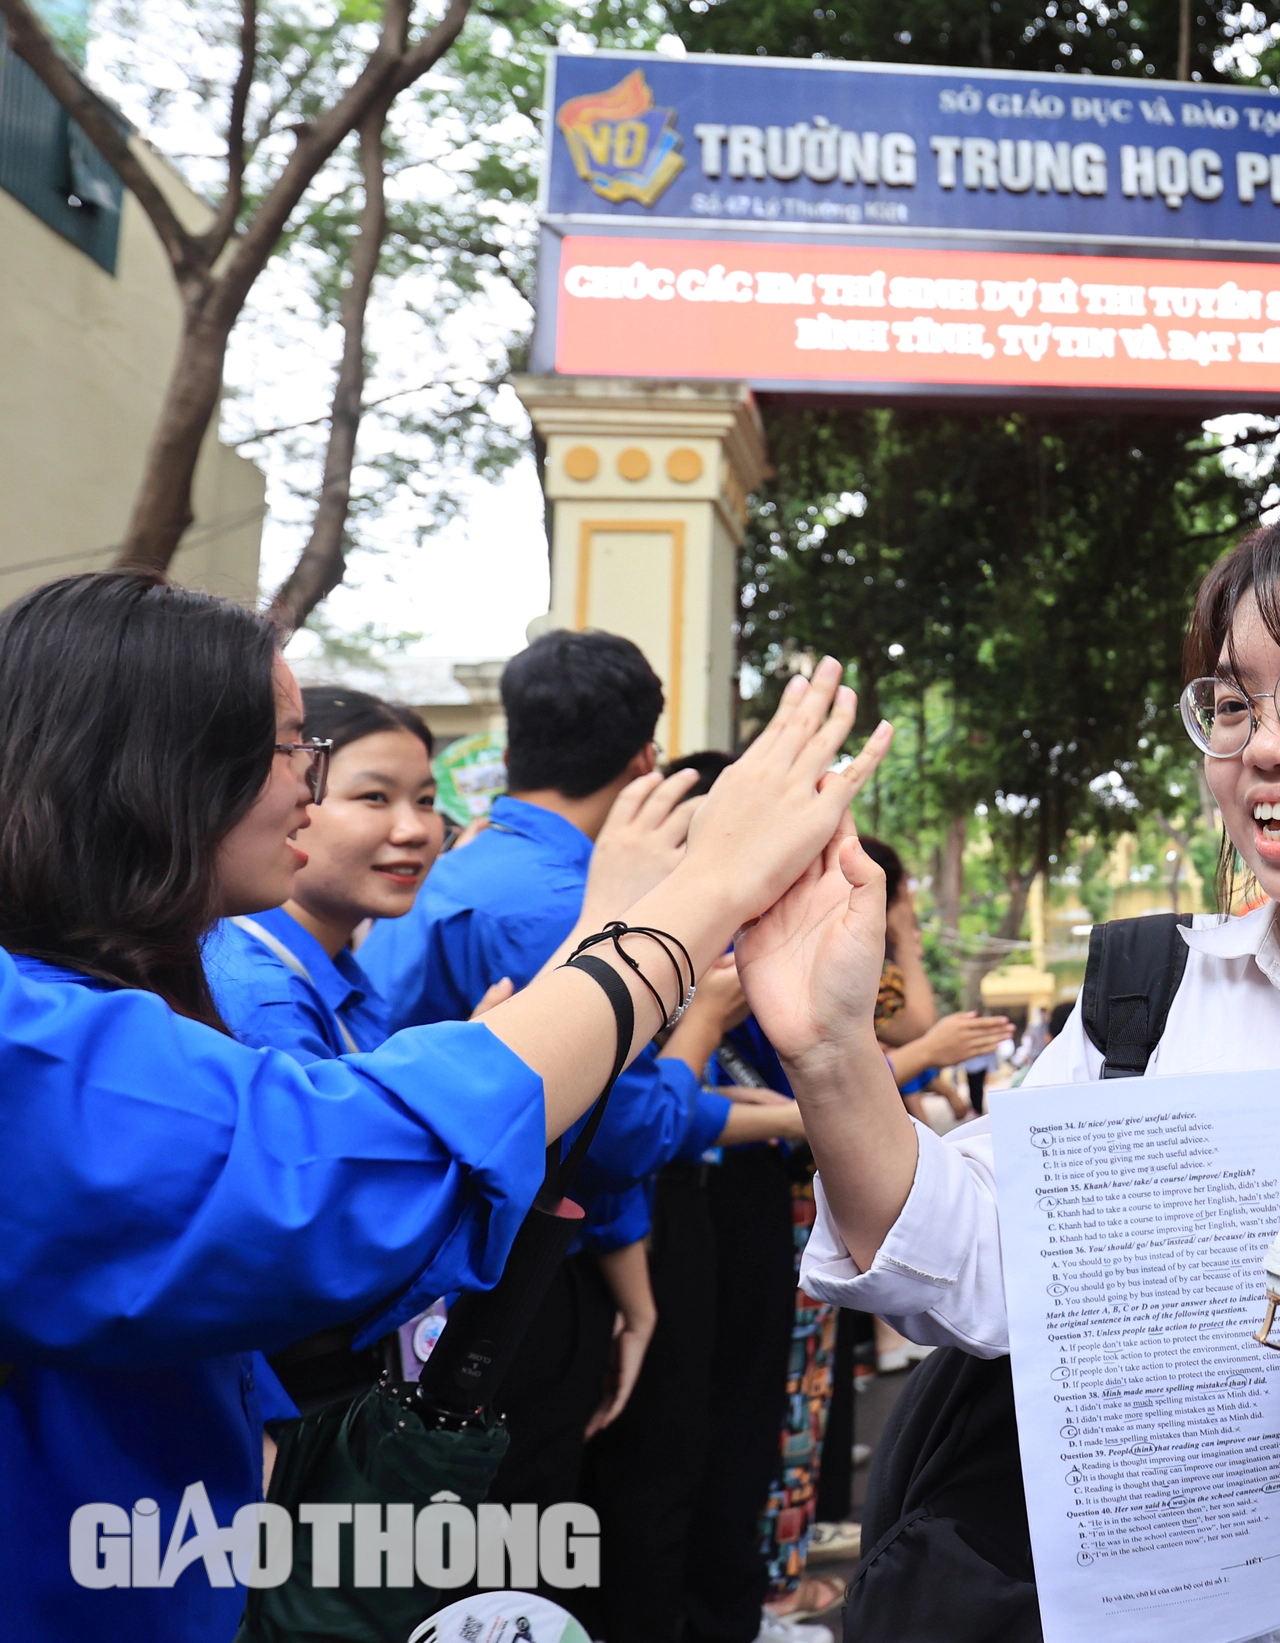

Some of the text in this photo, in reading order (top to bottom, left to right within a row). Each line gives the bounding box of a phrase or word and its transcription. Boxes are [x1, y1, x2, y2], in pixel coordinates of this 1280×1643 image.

[939, 84, 983, 115] SỞ
[986, 88, 1066, 119] GIÁO
[1070, 95, 1134, 128] DỤC
[1139, 96, 1174, 126] VÀ
[1181, 99, 1239, 130] ĐÀO
[695, 115, 917, 188] TRƯỜNG
[931, 134, 1107, 196] TRUNG
[1121, 144, 1223, 209] HỌC
[690, 191, 722, 215] Số
[565, 261, 674, 302] CHÚC
[676, 265, 753, 303] CÁC
[755, 271, 814, 305] EM
[816, 271, 887, 308] THÍ
[889, 277, 978, 312] SINH
[980, 279, 1035, 318] DỰ
[1080, 282, 1144, 316] THI
[795, 312, 889, 352] BÌNH
[998, 324, 1053, 361] TỰ
[1054, 326, 1116, 358] TIN
[1119, 323, 1166, 361] VÀ
[1170, 330, 1235, 365] ĐẠT
[1029, 1123, 1062, 1133] Question
[1077, 1121, 1087, 1130] It/
[1087, 1119, 1106, 1129] nice/
[1107, 1117, 1125, 1127] you/
[1125, 1116, 1142, 1125] give/
[1144, 1113, 1170, 1123] useful/
[1171, 1110, 1196, 1119] advice.
[1035, 1185, 1068, 1195] Question
[1083, 1181, 1111, 1192] Khanh/
[1112, 1179, 1132, 1189] have/
[1133, 1177, 1153, 1187] take/
[1159, 1174, 1187, 1185] course/
[1188, 1171, 1221, 1182] improve/
[1222, 1168, 1255, 1179] English?
[1059, 1233, 1083, 1242] Khanh
[1156, 1223, 1193, 1235] improving
[1194, 1222, 1206, 1230] her
[1208, 1219, 1238, 1230] English,
[1059, 1318, 1089, 1329] original
[1090, 1316, 1121, 1324] sentence
[1132, 1313, 1149, 1321] each
[1152, 1312, 1160, 1321] of
[1173, 1308, 1209, 1319] following
[1211, 1305, 1247, 1316] questions.
[467, 1352, 492, 1364] CLOSE
[461, 1367, 482, 1377] OPEN
[1053, 1392, 1086, 1401] Question
[1101, 1389, 1121, 1397] Minh
[1123, 1387, 1143, 1395] made
[1165, 1383, 1194, 1393] spelling
[1195, 1380, 1227, 1389] mistakes
[1119, 1434, 1148, 1444] spelling
[1149, 1431, 1181, 1440] mistakes
[1182, 1429, 1197, 1437] than
[1199, 1427, 1219, 1435] Minh
[1066, 1508, 1099, 1519] Question
[1114, 1505, 1128, 1513] Her
[1144, 1501, 1160, 1509] said
[1197, 1494, 1208, 1502] the
[1210, 1490, 1234, 1500] school
[1235, 1486, 1262, 1496] canteen
